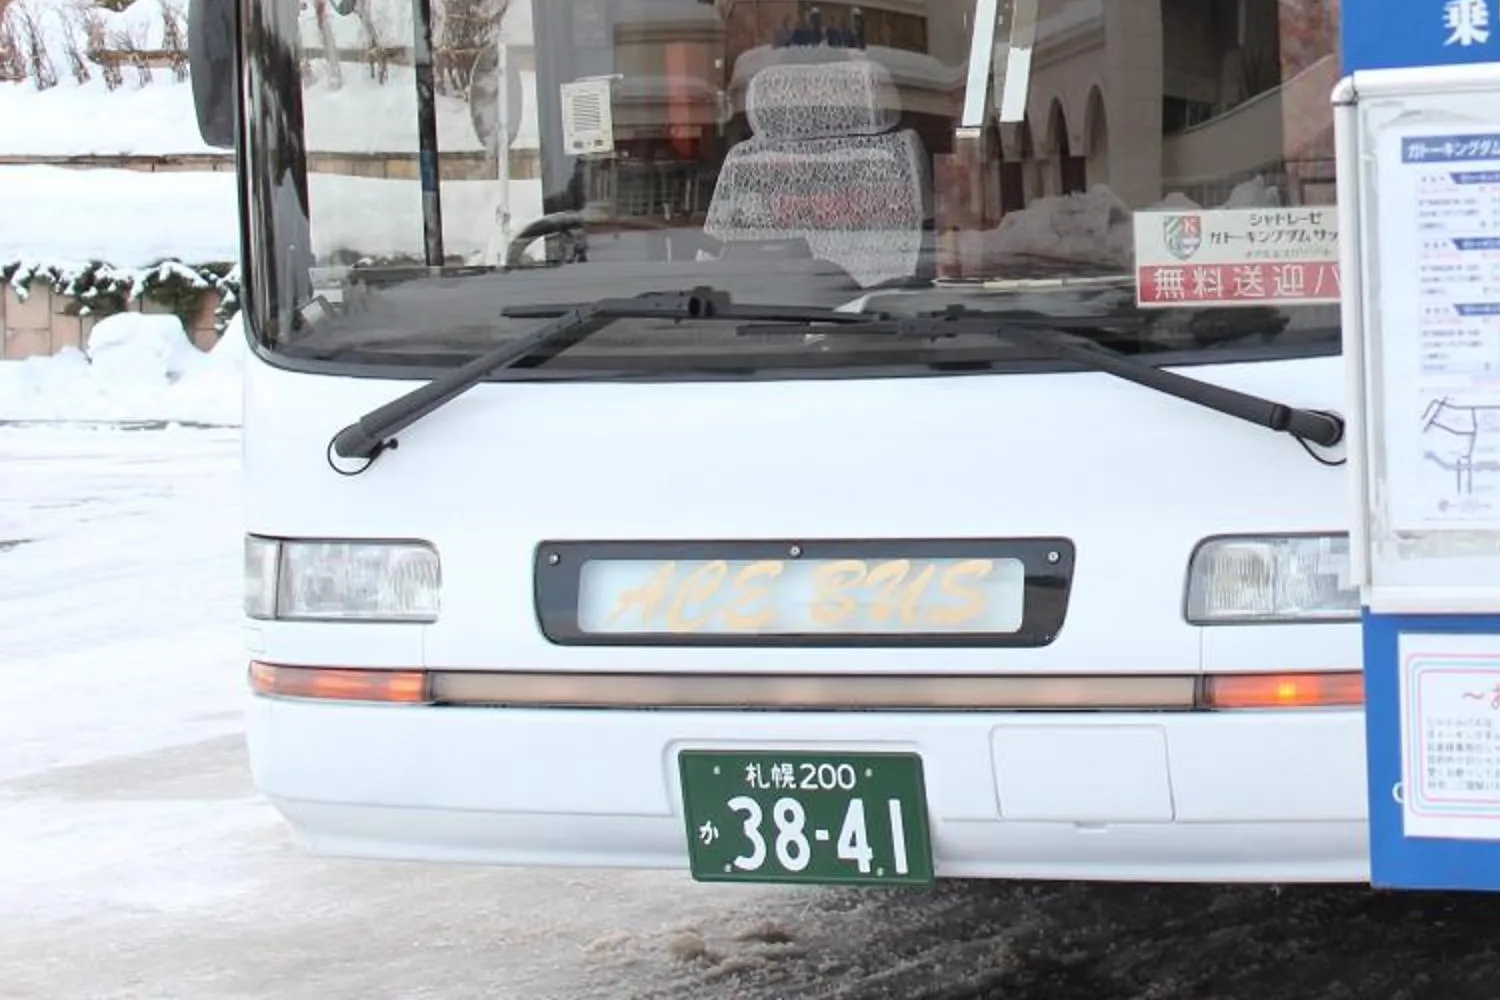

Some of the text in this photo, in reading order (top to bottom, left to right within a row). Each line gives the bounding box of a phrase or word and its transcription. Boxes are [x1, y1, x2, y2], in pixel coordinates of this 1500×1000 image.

[608, 558, 994, 633] ACE BUS
[699, 795, 909, 875] か 38-41
